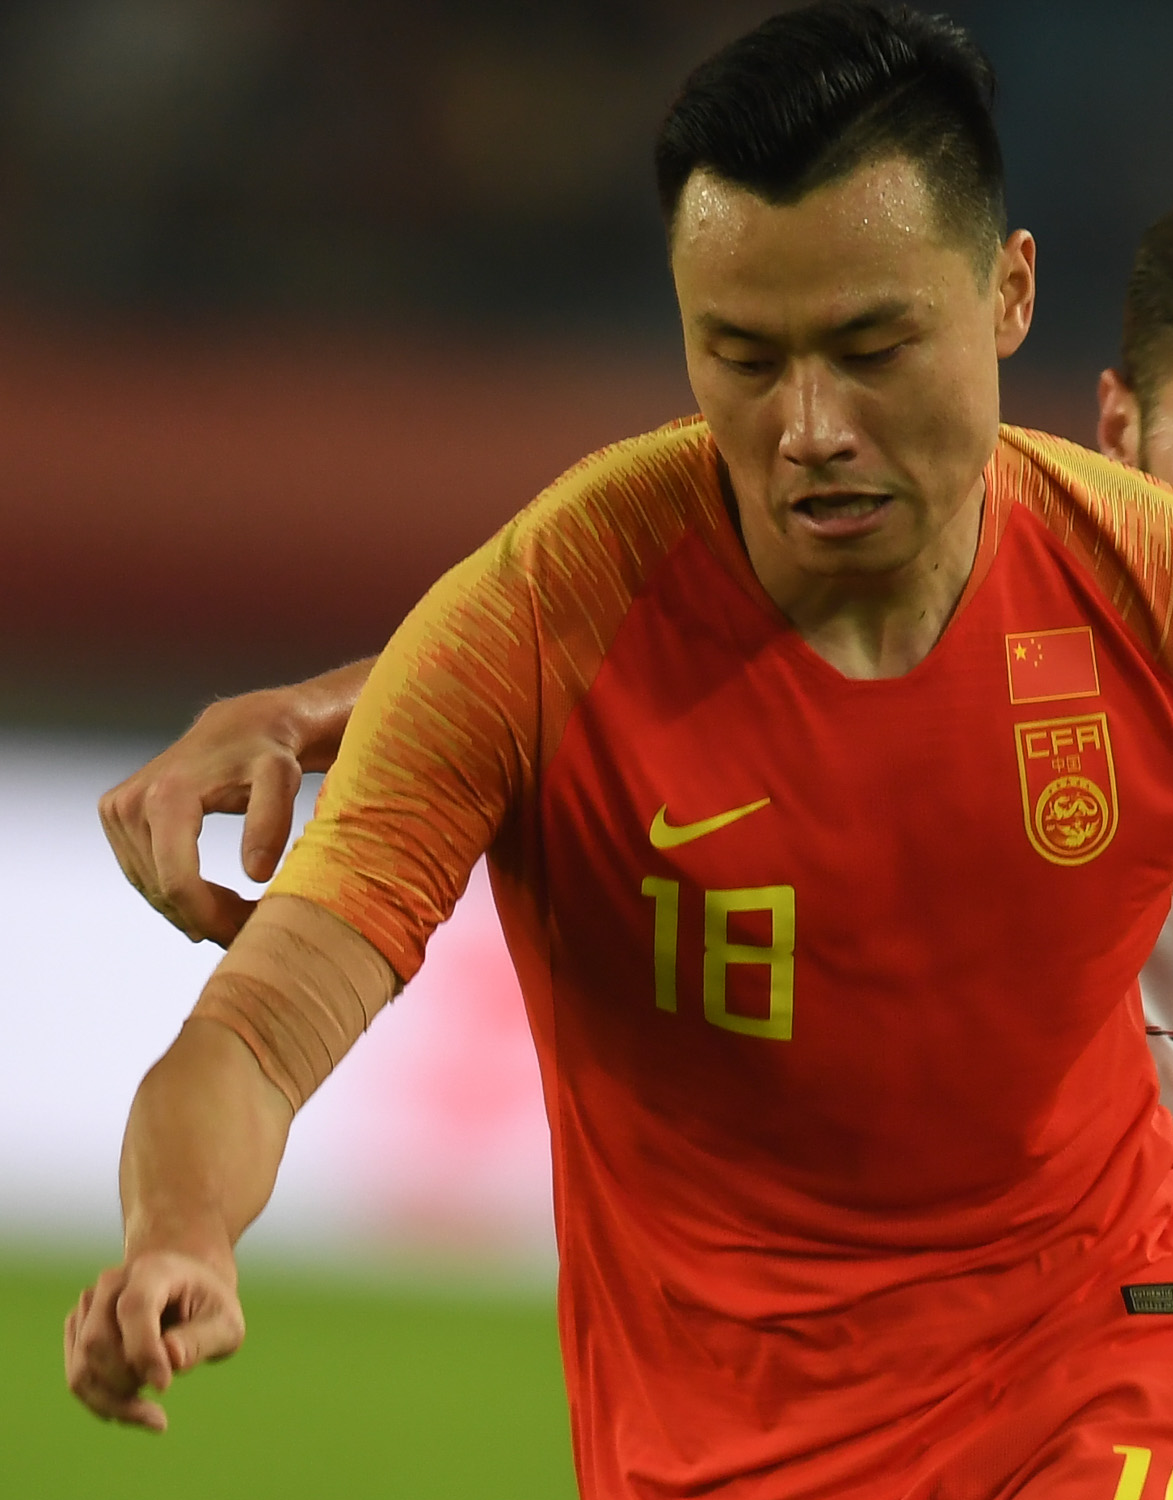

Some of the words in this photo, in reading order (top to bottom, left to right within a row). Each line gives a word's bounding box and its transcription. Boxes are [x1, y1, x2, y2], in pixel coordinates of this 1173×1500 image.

[1026, 725, 1101, 759] CFA
[1052, 755, 1081, 773] 中国
[641, 875, 796, 1041] 18
